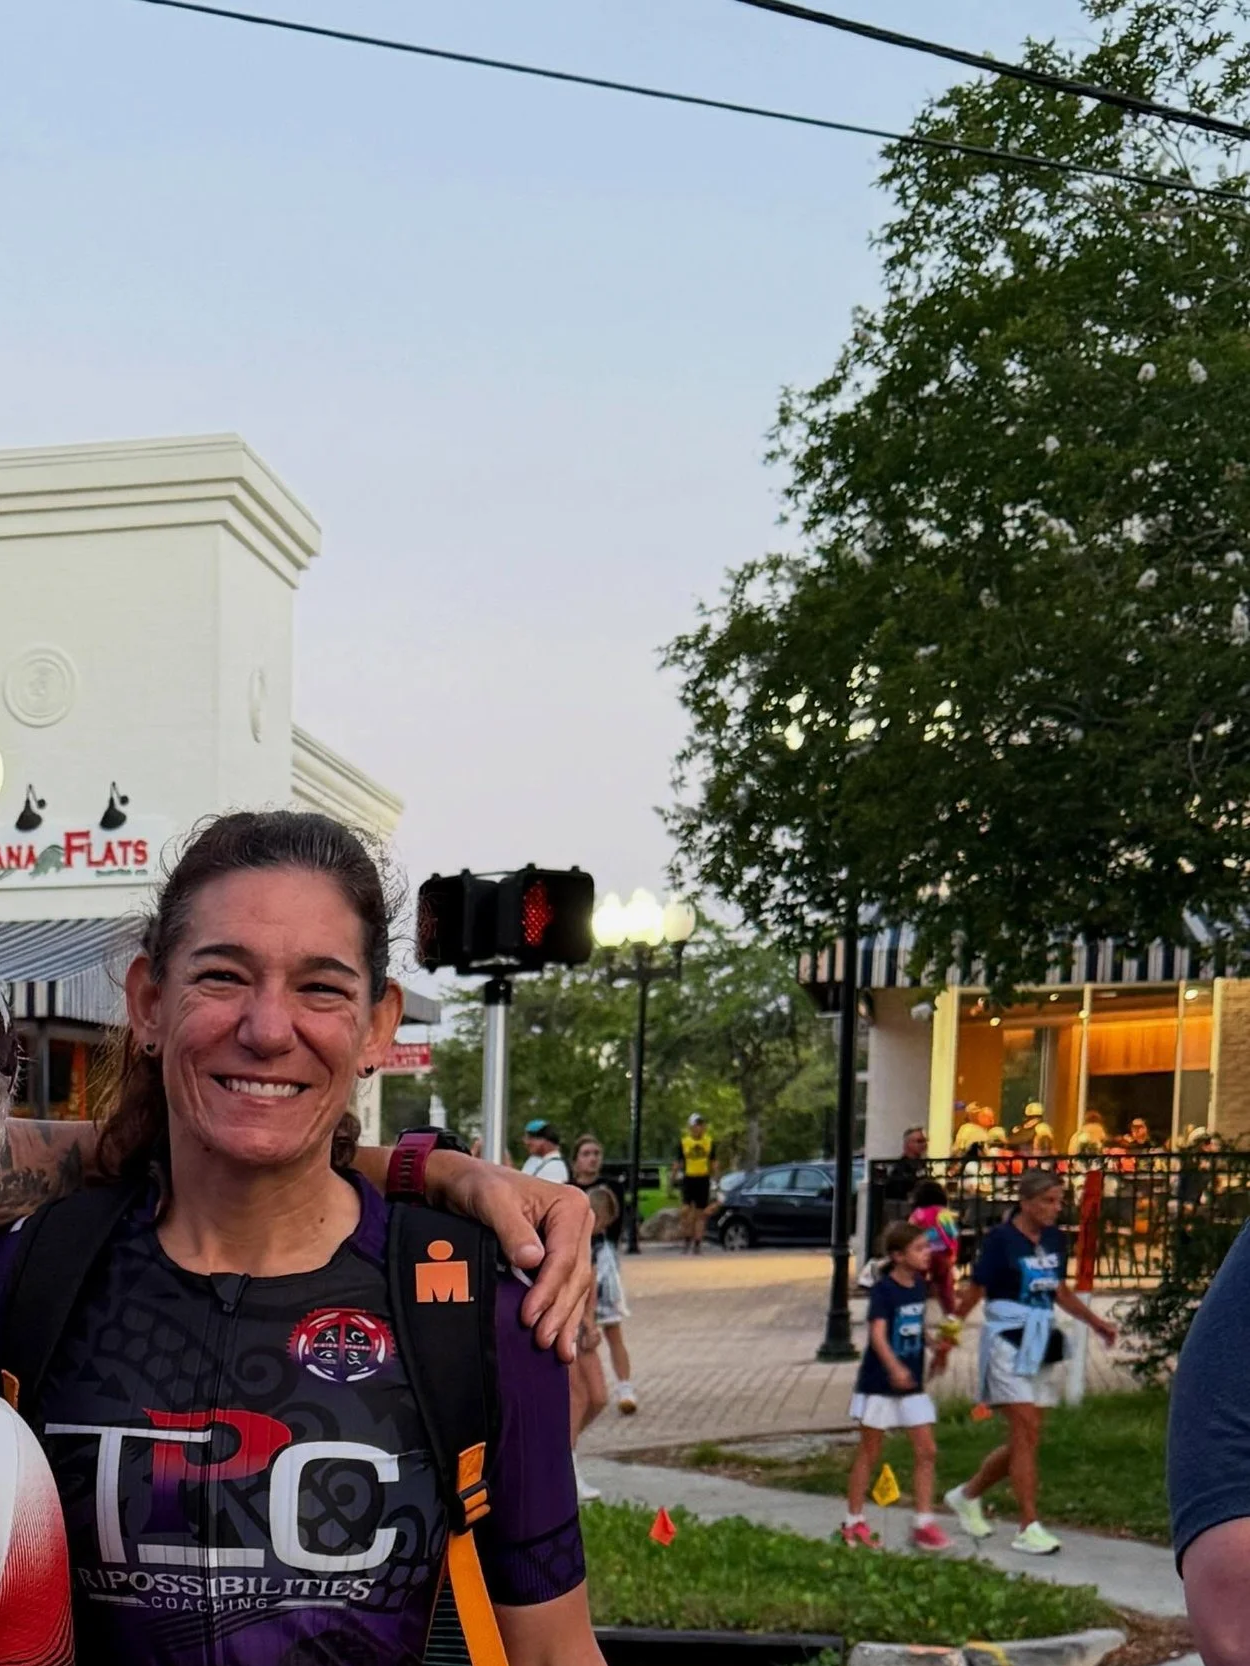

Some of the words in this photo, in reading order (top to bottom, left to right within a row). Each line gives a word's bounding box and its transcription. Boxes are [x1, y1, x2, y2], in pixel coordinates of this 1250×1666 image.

[64, 830, 148, 868] FLATS
[74, 1566, 376, 1601] RIPOSSIBILITIES
[151, 1595, 268, 1613] COACHING
